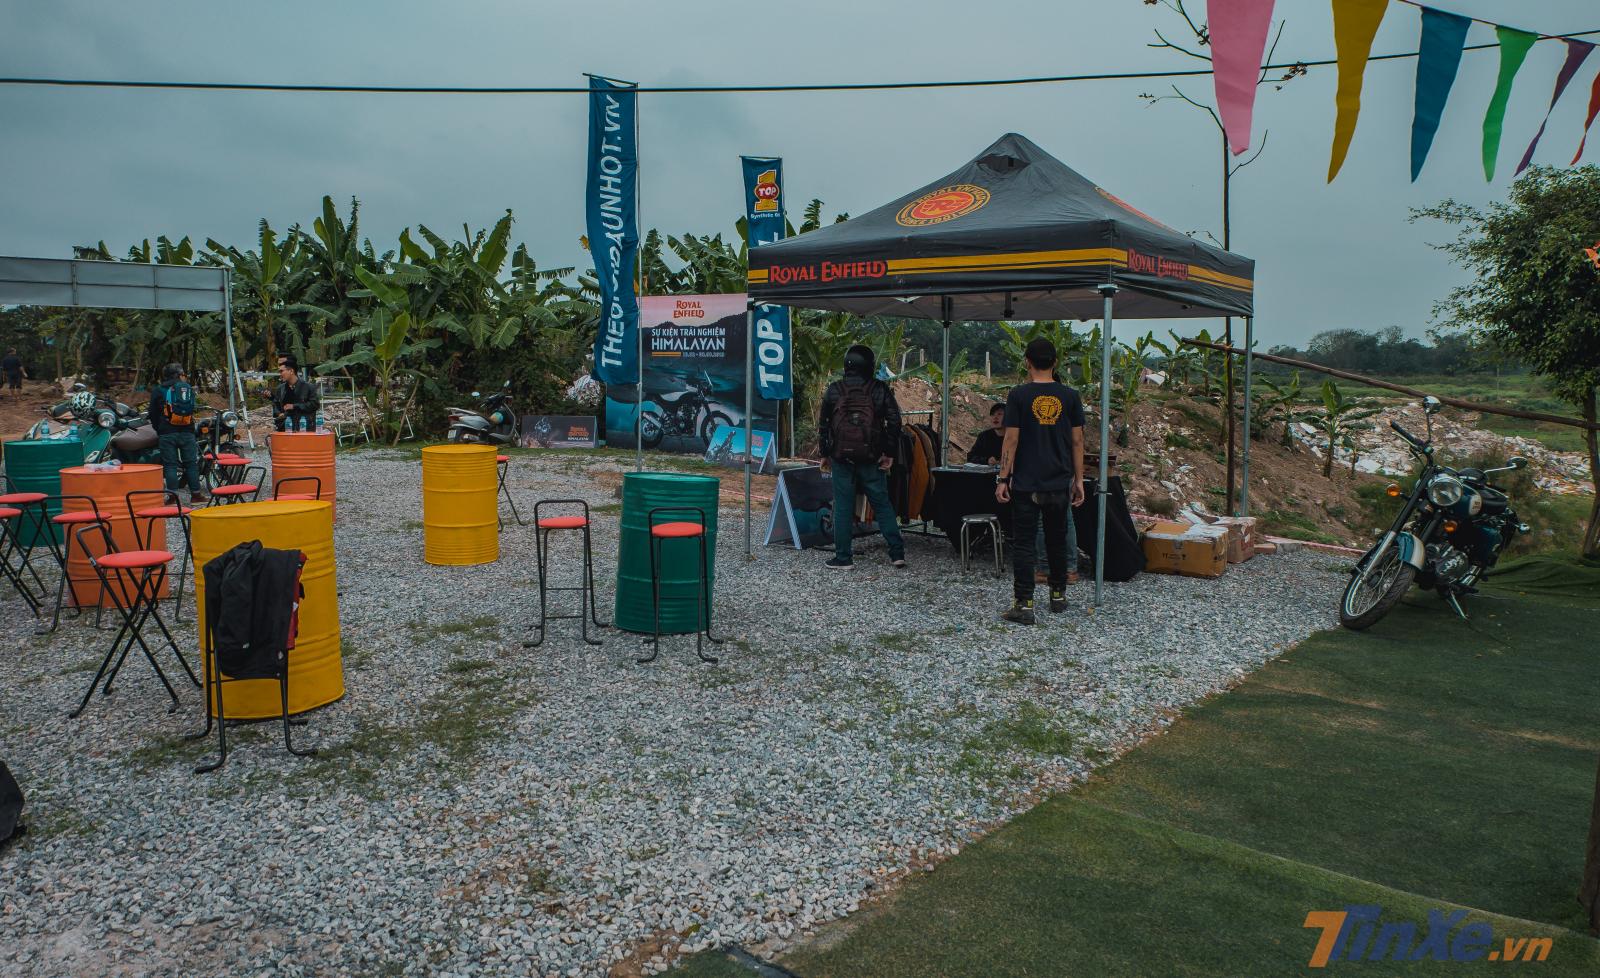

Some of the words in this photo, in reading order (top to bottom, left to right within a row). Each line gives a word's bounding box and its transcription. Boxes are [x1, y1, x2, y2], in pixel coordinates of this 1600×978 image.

[759, 187, 777, 196] TOP
[599, 94, 625, 367] THEGDAUNHOT.VN
[770, 265, 817, 284] ROYAL
[821, 260, 886, 282] ENFIELD
[1128, 248, 1155, 272] ROYAL
[1157, 255, 1188, 280] ENFIELD
[676, 300, 702, 309] ROYAL
[673, 310, 705, 318] ENFIELD
[651, 338, 726, 351] HIMALAYAN
[756, 318, 785, 388] TOP
